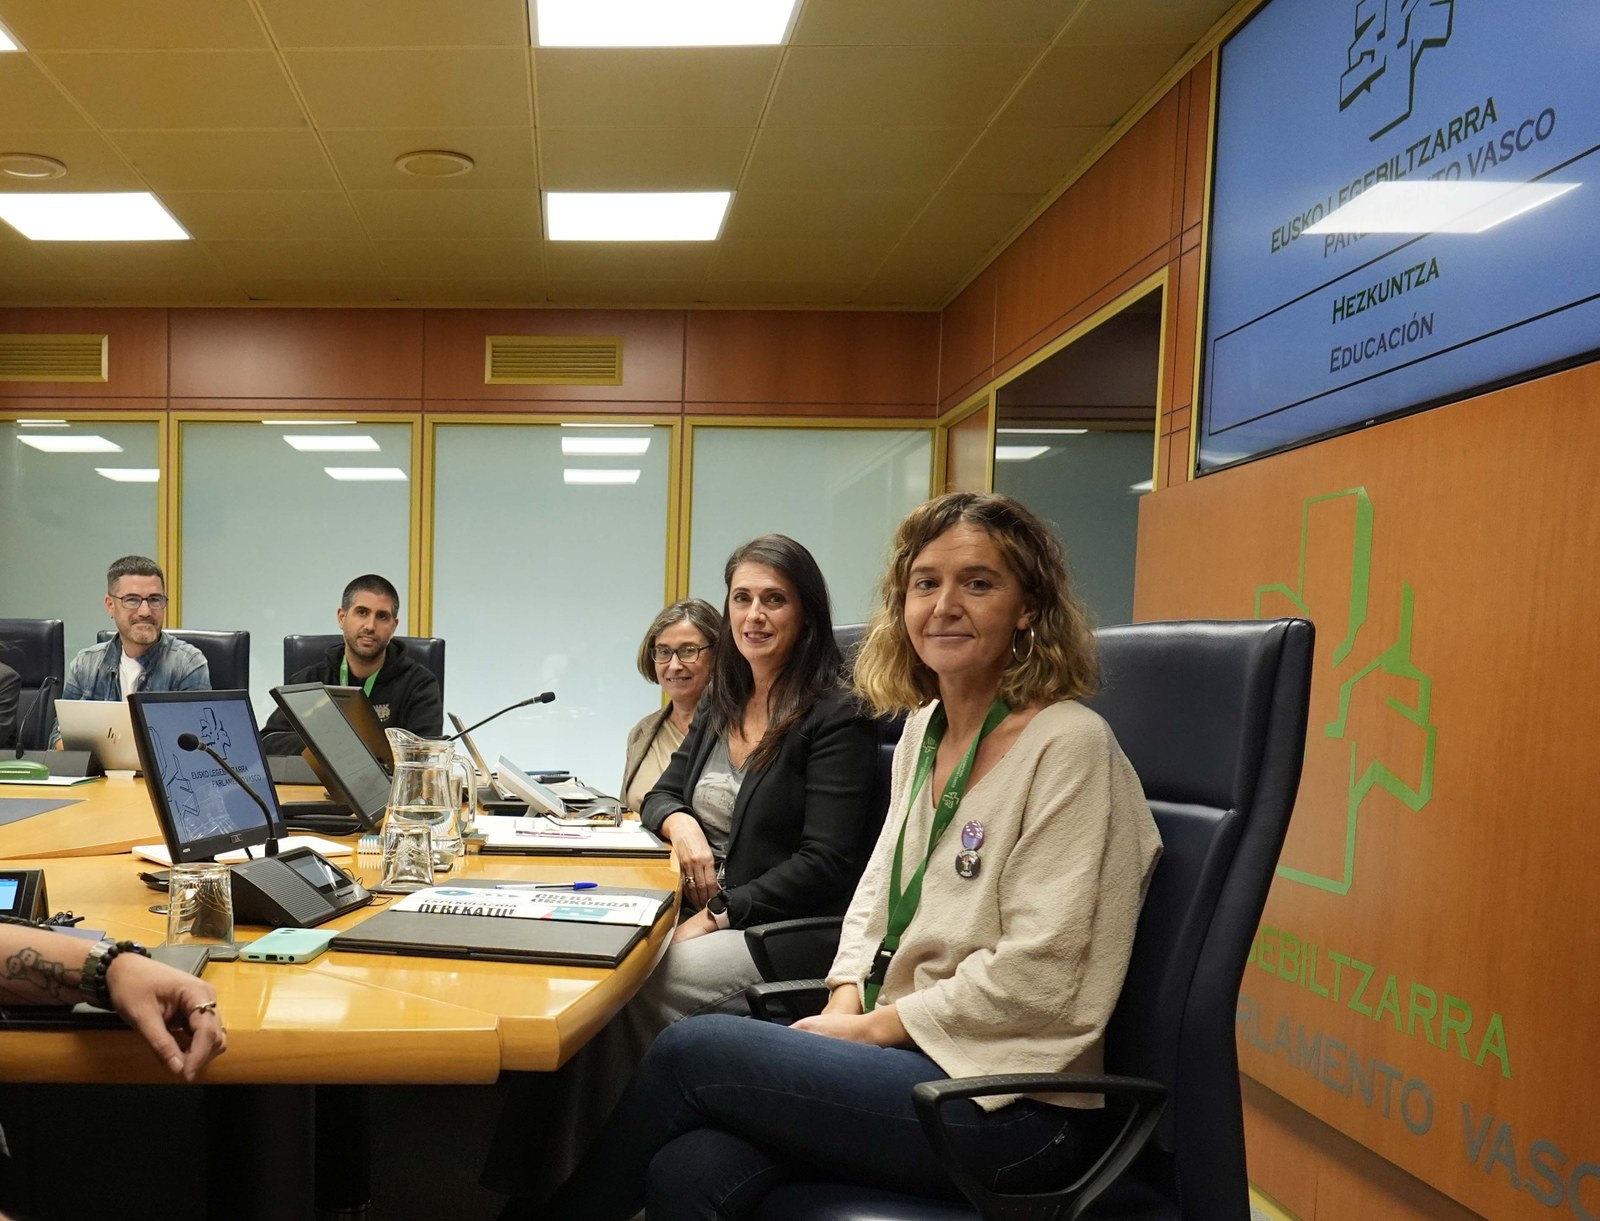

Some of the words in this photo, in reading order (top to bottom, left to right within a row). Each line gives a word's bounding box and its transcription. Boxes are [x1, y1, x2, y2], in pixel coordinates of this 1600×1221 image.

[1467, 107, 1556, 178] VASCO
[1271, 202, 1324, 254] EUSKO
[1332, 256, 1441, 325] HEZKUNTZA
[1329, 311, 1435, 374] EDUCACIÓN
